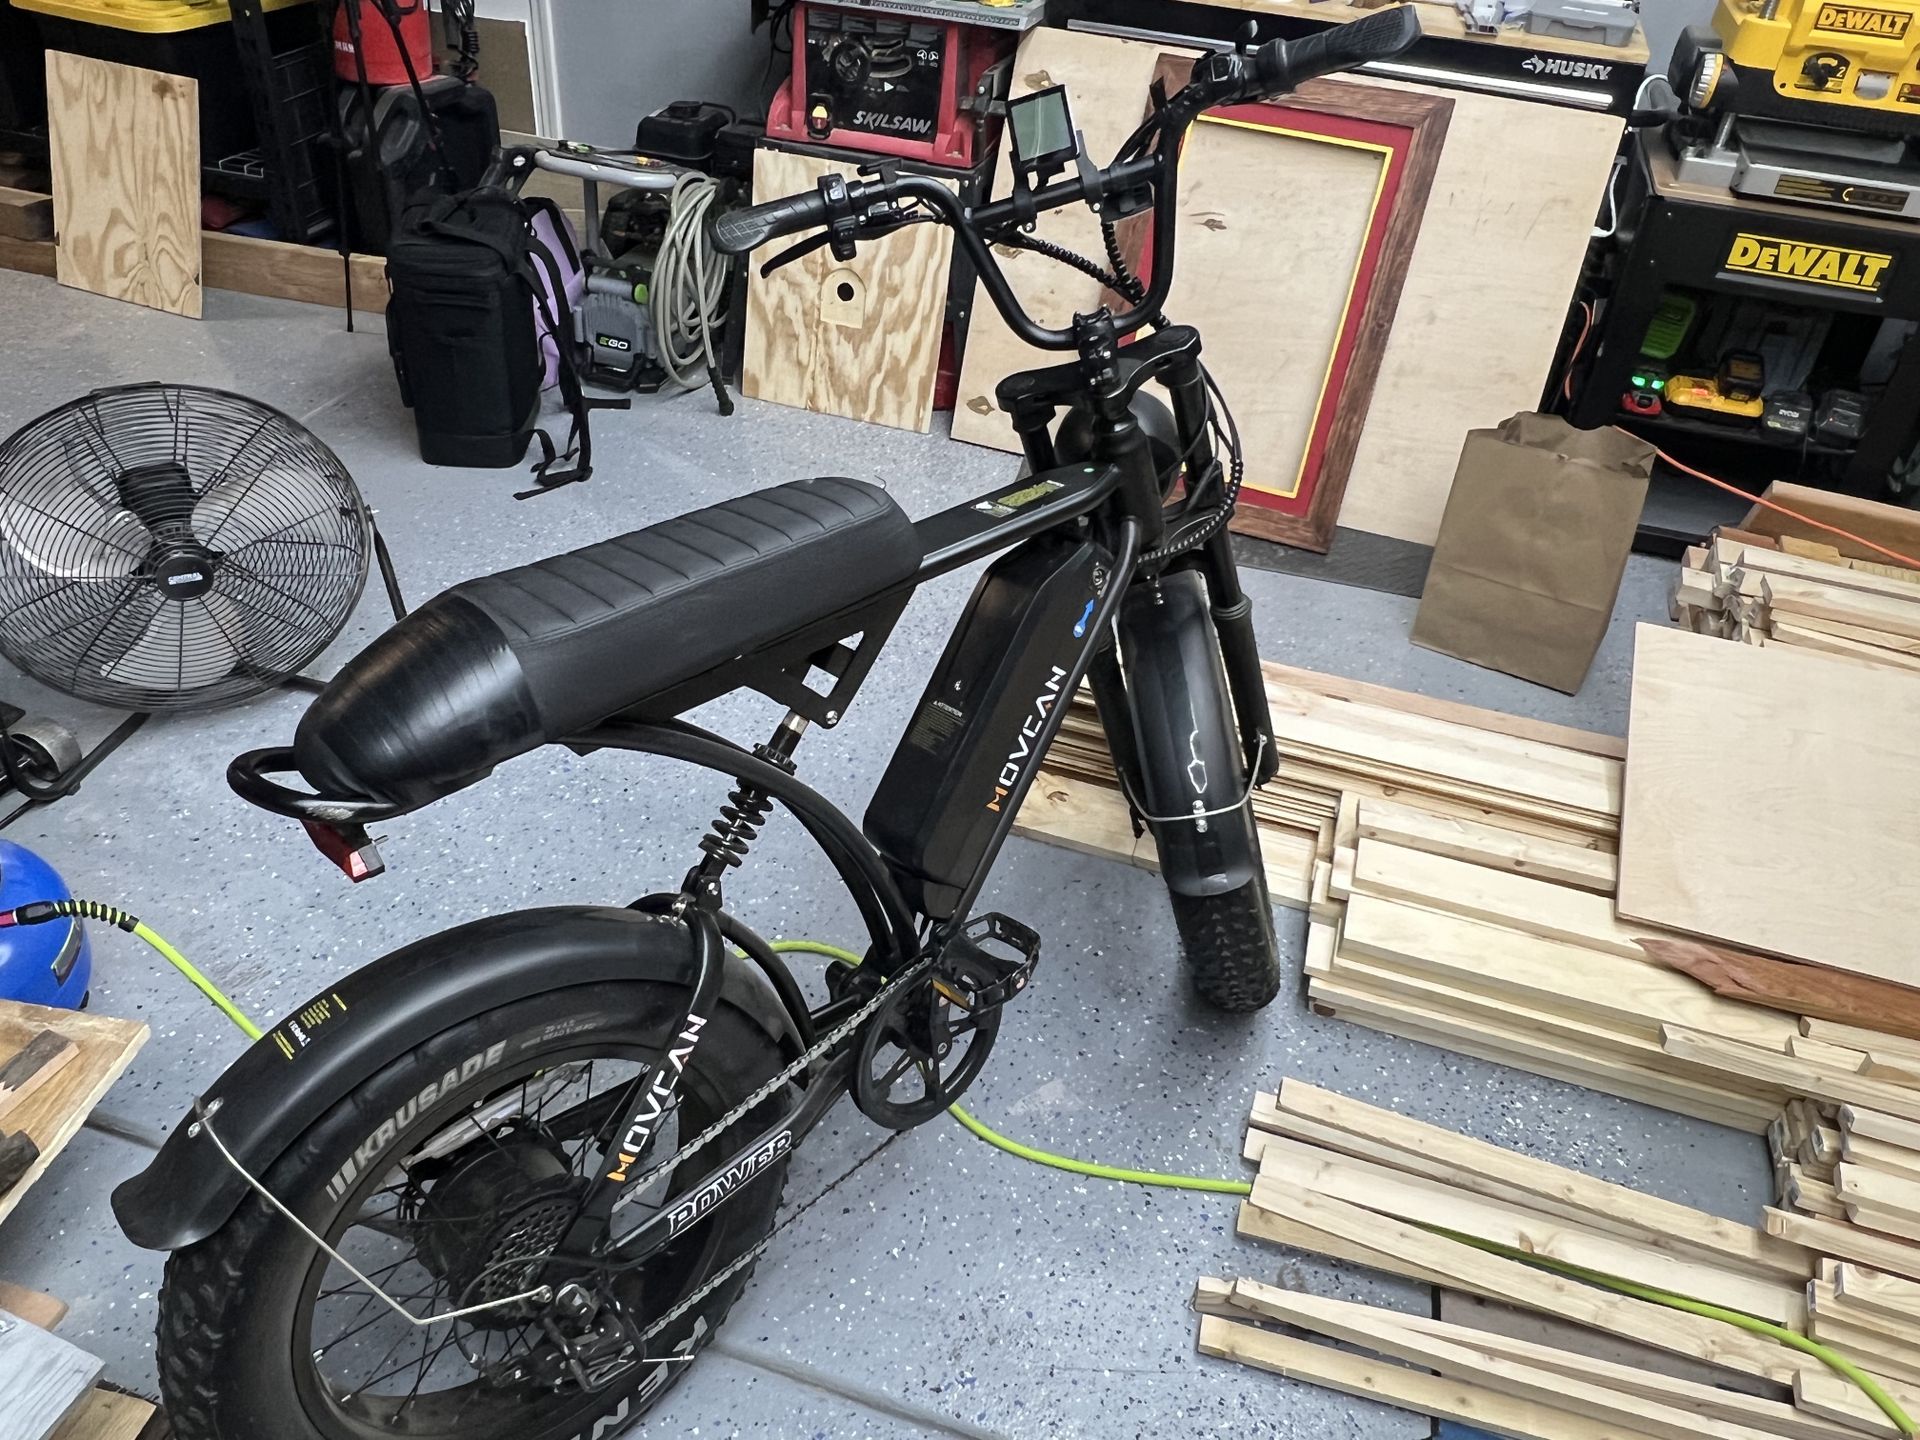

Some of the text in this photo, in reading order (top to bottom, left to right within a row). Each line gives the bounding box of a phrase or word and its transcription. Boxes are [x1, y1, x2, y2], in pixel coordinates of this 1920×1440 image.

[1817, 8, 1909, 34] DEWALT
[1544, 58, 1613, 80] HUSKY
[853, 110, 931, 134] SKILSAW
[1727, 236, 1890, 287] DEWALT
[986, 665, 1067, 812] MOVCAN
[353, 1040, 508, 1170] KRUSADE
[606, 1013, 708, 1182] MOVCAN
[667, 1130, 792, 1236] POWER
